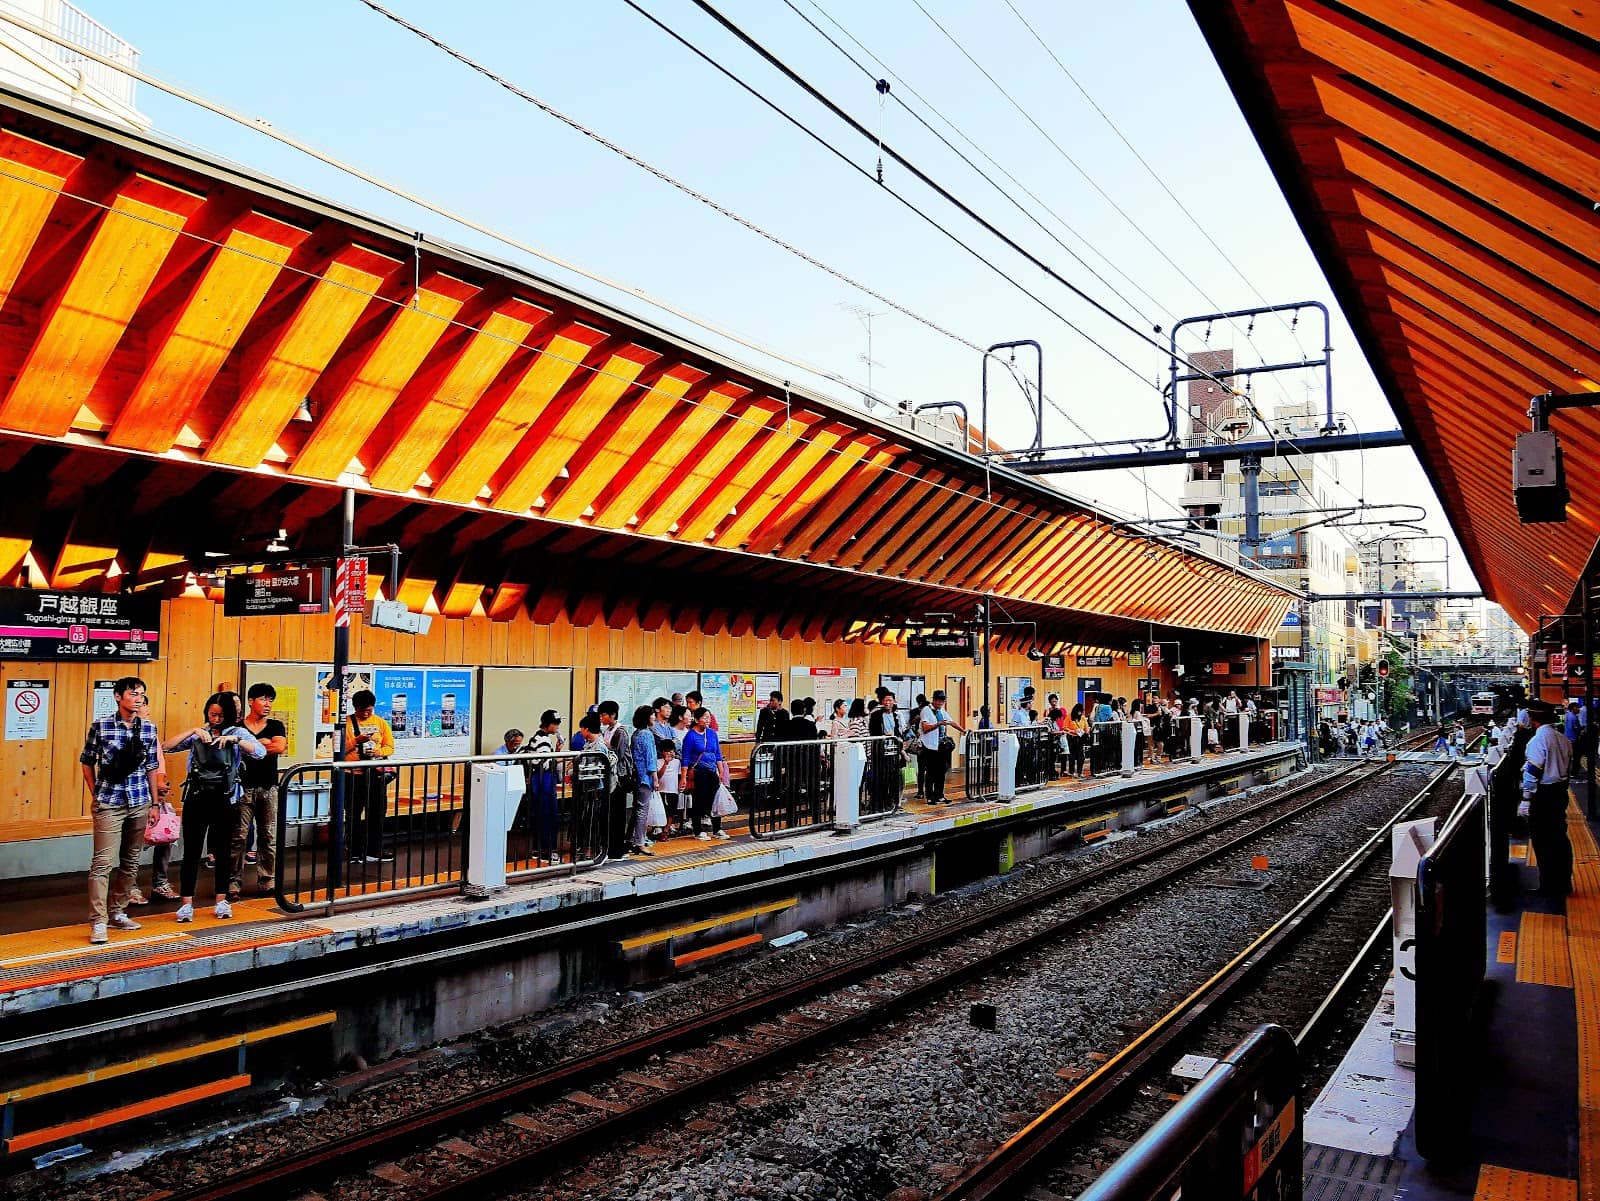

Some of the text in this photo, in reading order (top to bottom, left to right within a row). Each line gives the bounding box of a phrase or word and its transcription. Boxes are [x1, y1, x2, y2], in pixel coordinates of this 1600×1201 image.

[306, 573, 313, 602] 1
[38, 595, 118, 616] 戸越銀座
[24, 613, 77, 624] Togoshi-ginza
[1278, 648, 1300, 658] LION
